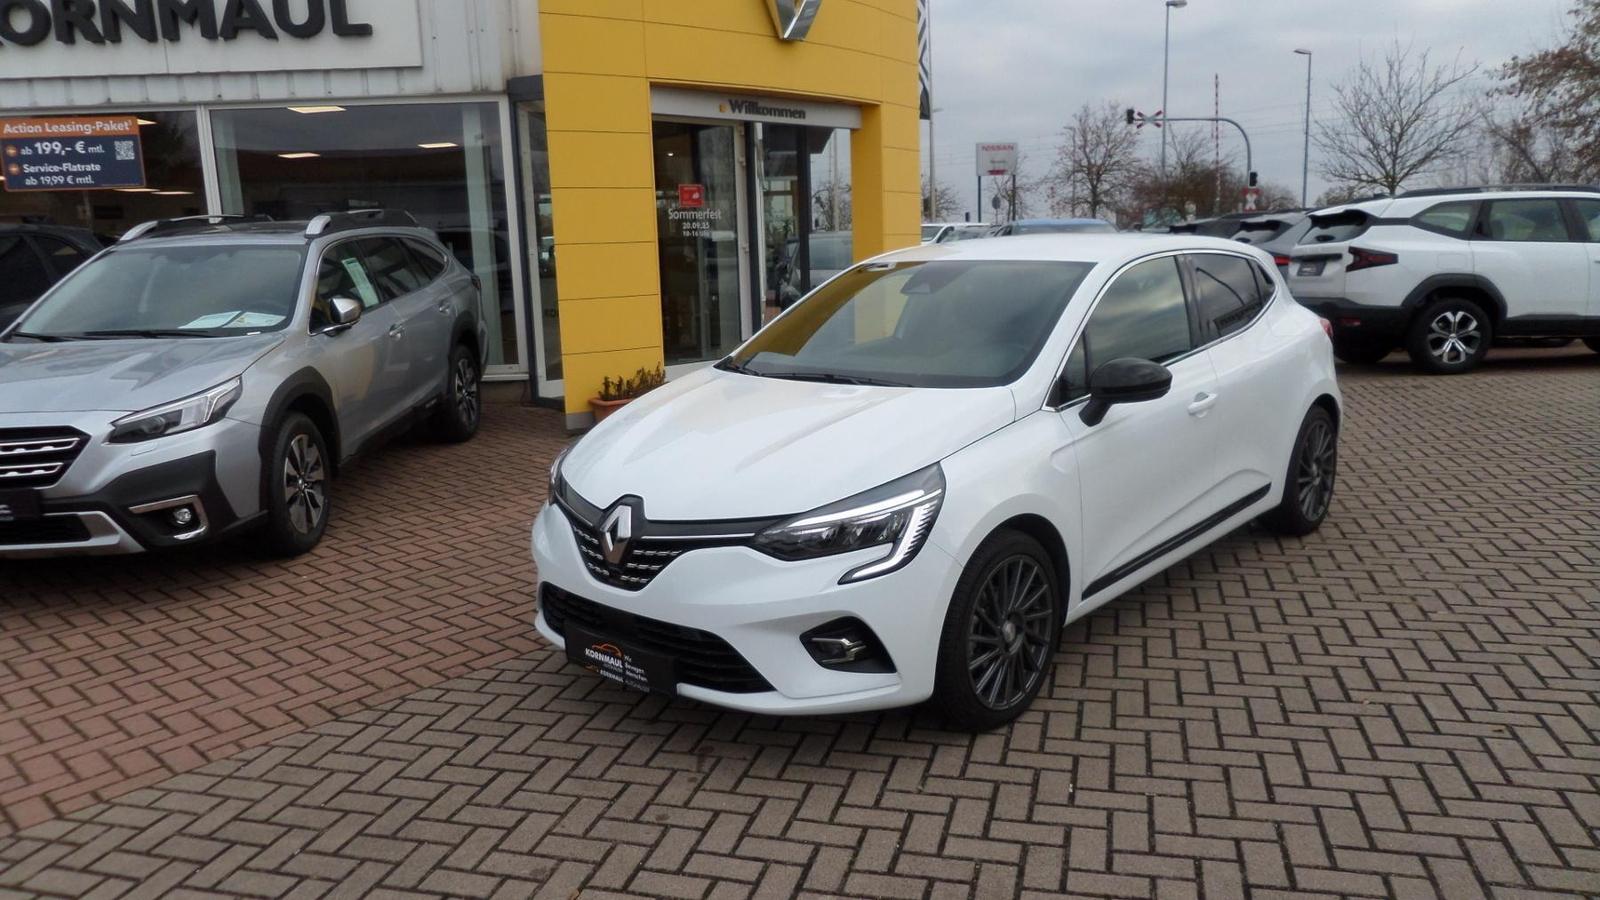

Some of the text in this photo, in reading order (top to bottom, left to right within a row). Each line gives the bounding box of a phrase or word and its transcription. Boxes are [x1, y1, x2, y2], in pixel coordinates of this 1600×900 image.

[0, 0, 373, 47] ORNMAUL
[728, 99, 806, 120] Willkommen
[3, 122, 42, 134] Action
[20, 146, 33, 155] ab
[75, 140, 87, 154] €
[88, 145, 105, 154] mtl.
[23, 163, 101, 174] Service-Flatrate
[25, 174, 95, 186] ab 19,99 € mtl.
[668, 207, 721, 220] Sommerfest
[585, 648, 623, 668] KORNMAUL
